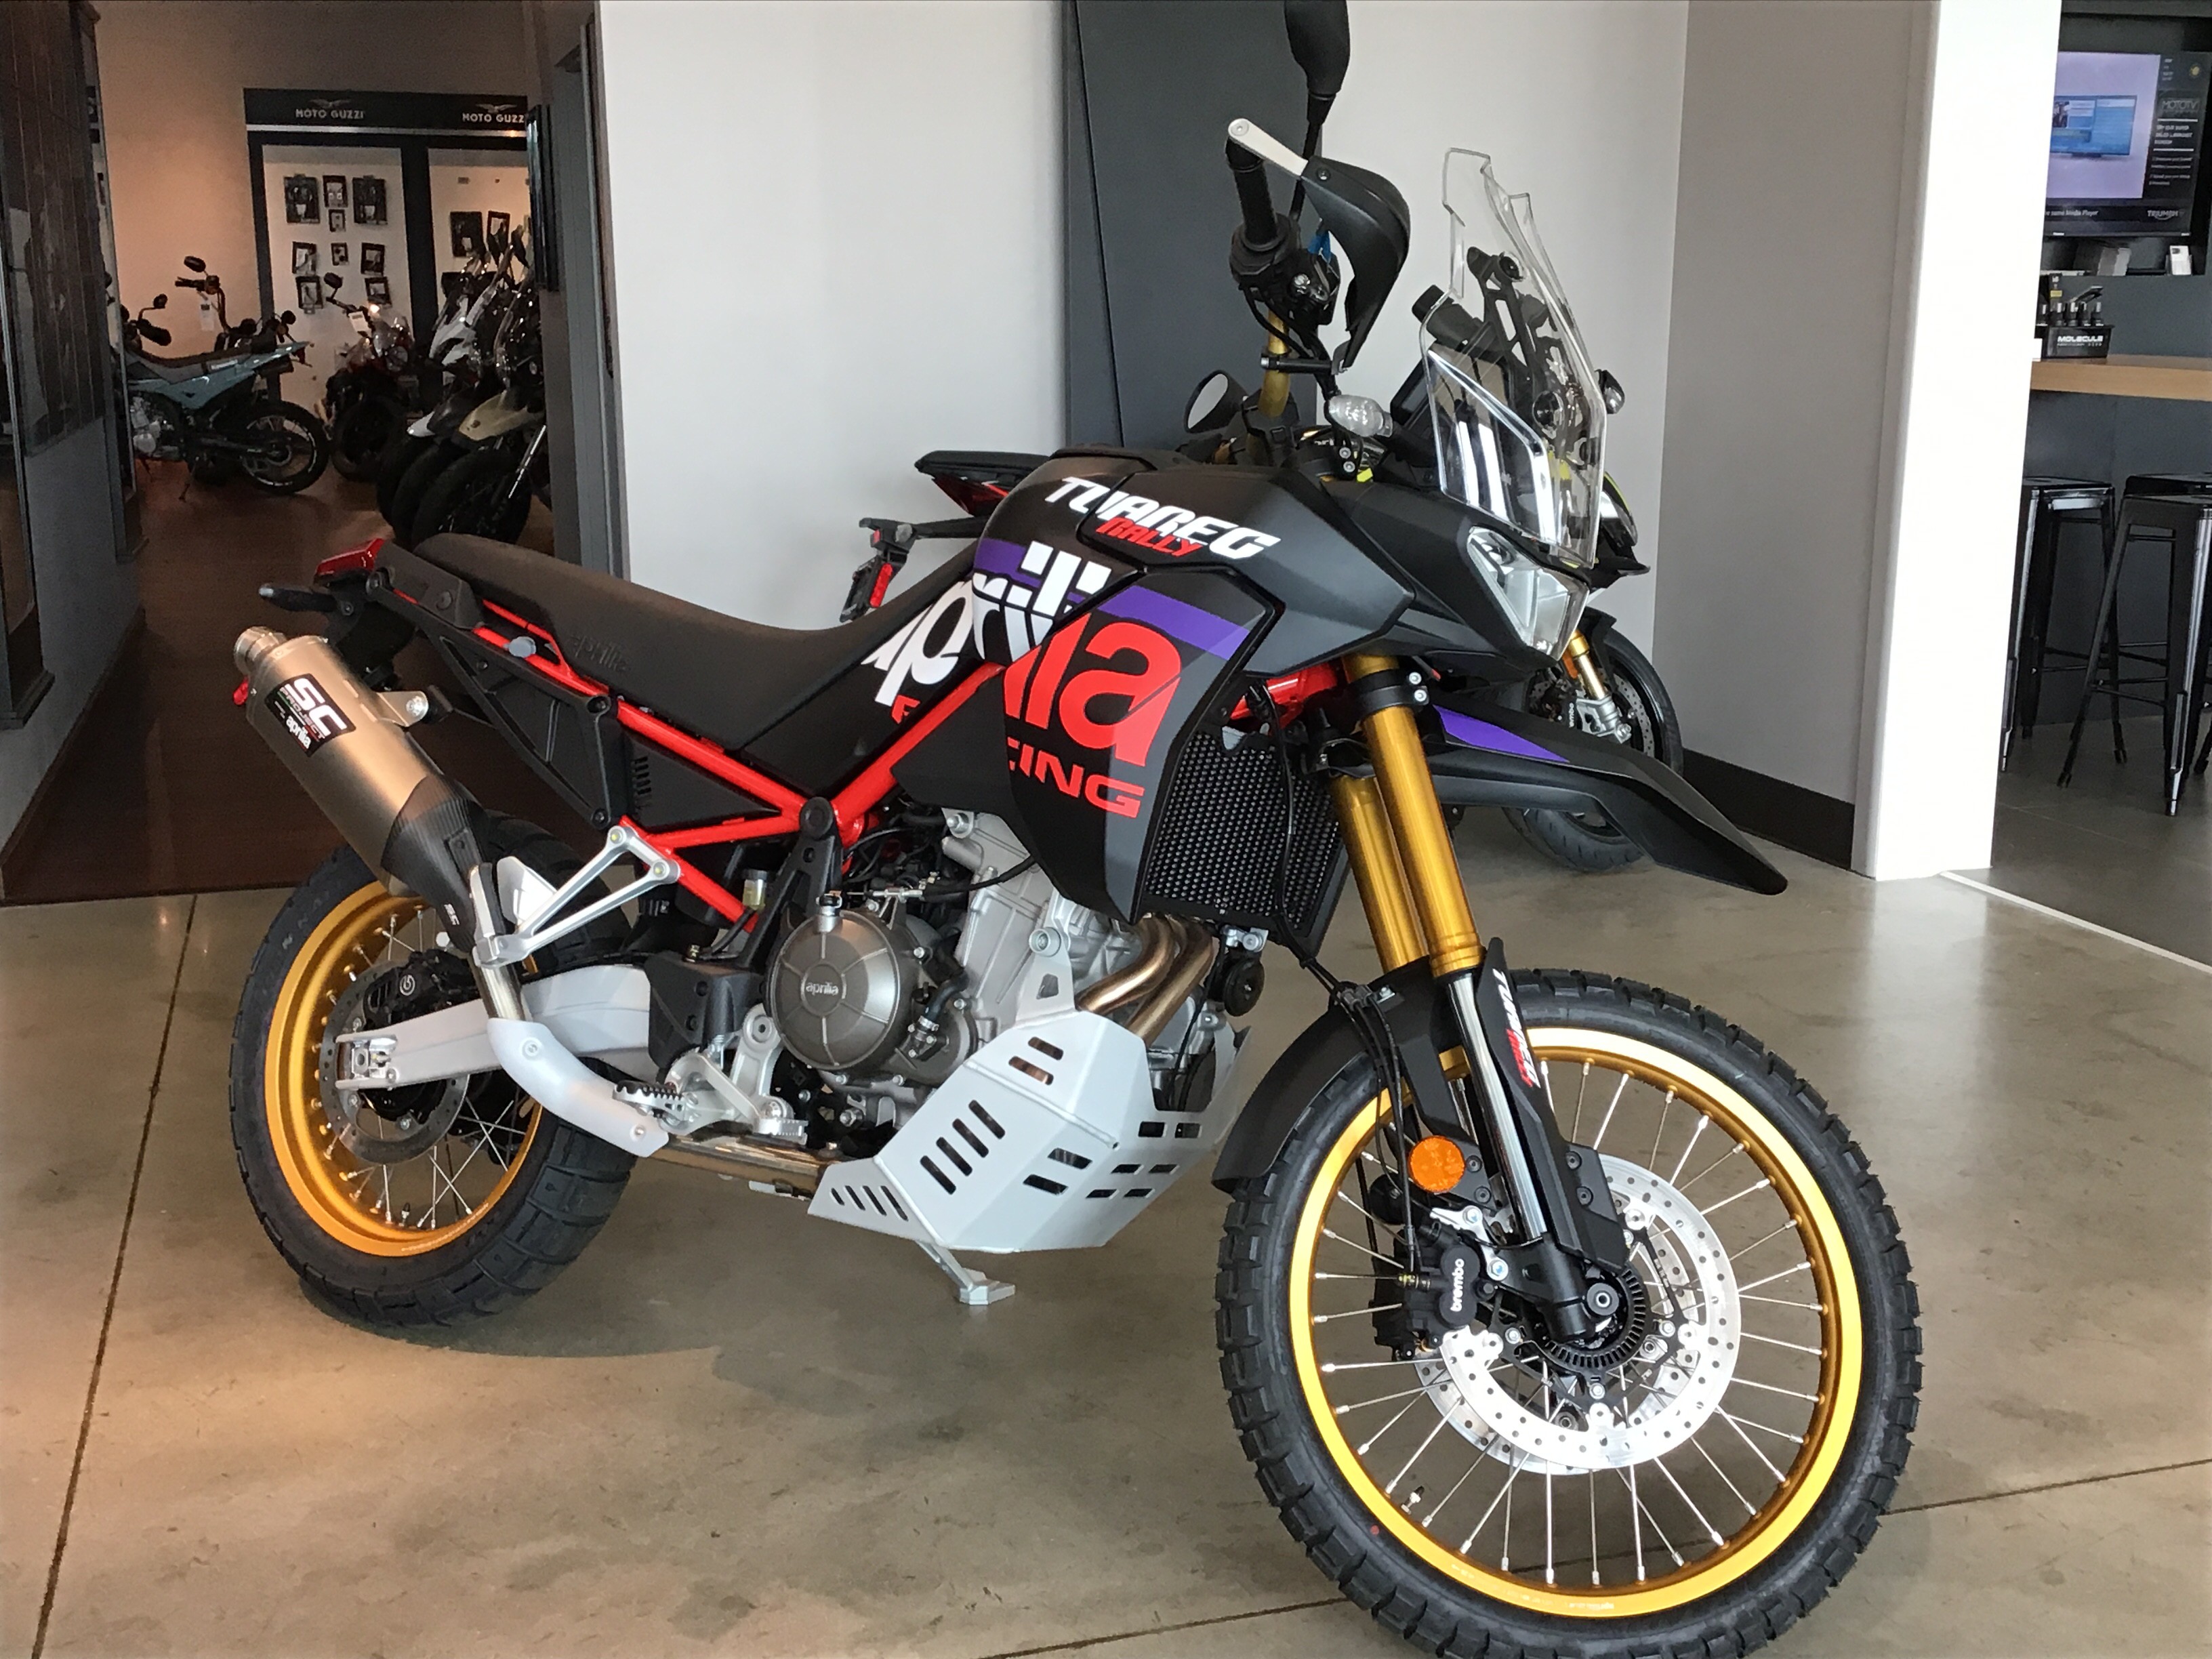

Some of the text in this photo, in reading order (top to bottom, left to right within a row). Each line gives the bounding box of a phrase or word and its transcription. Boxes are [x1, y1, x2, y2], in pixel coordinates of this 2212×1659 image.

[295, 108, 364, 119] MOTO GUZZI
[462, 112, 525, 123] MOTO GUZZ
[1044, 476, 1282, 560] TUAREG
[1095, 516, 1204, 558] RALLY
[284, 677, 348, 737] SC
[285, 714, 312, 750] aprilia
[805, 981, 839, 996] aprilia
[1492, 968, 1542, 1089] TUAREG
[1450, 1258, 1465, 1312] brembo
